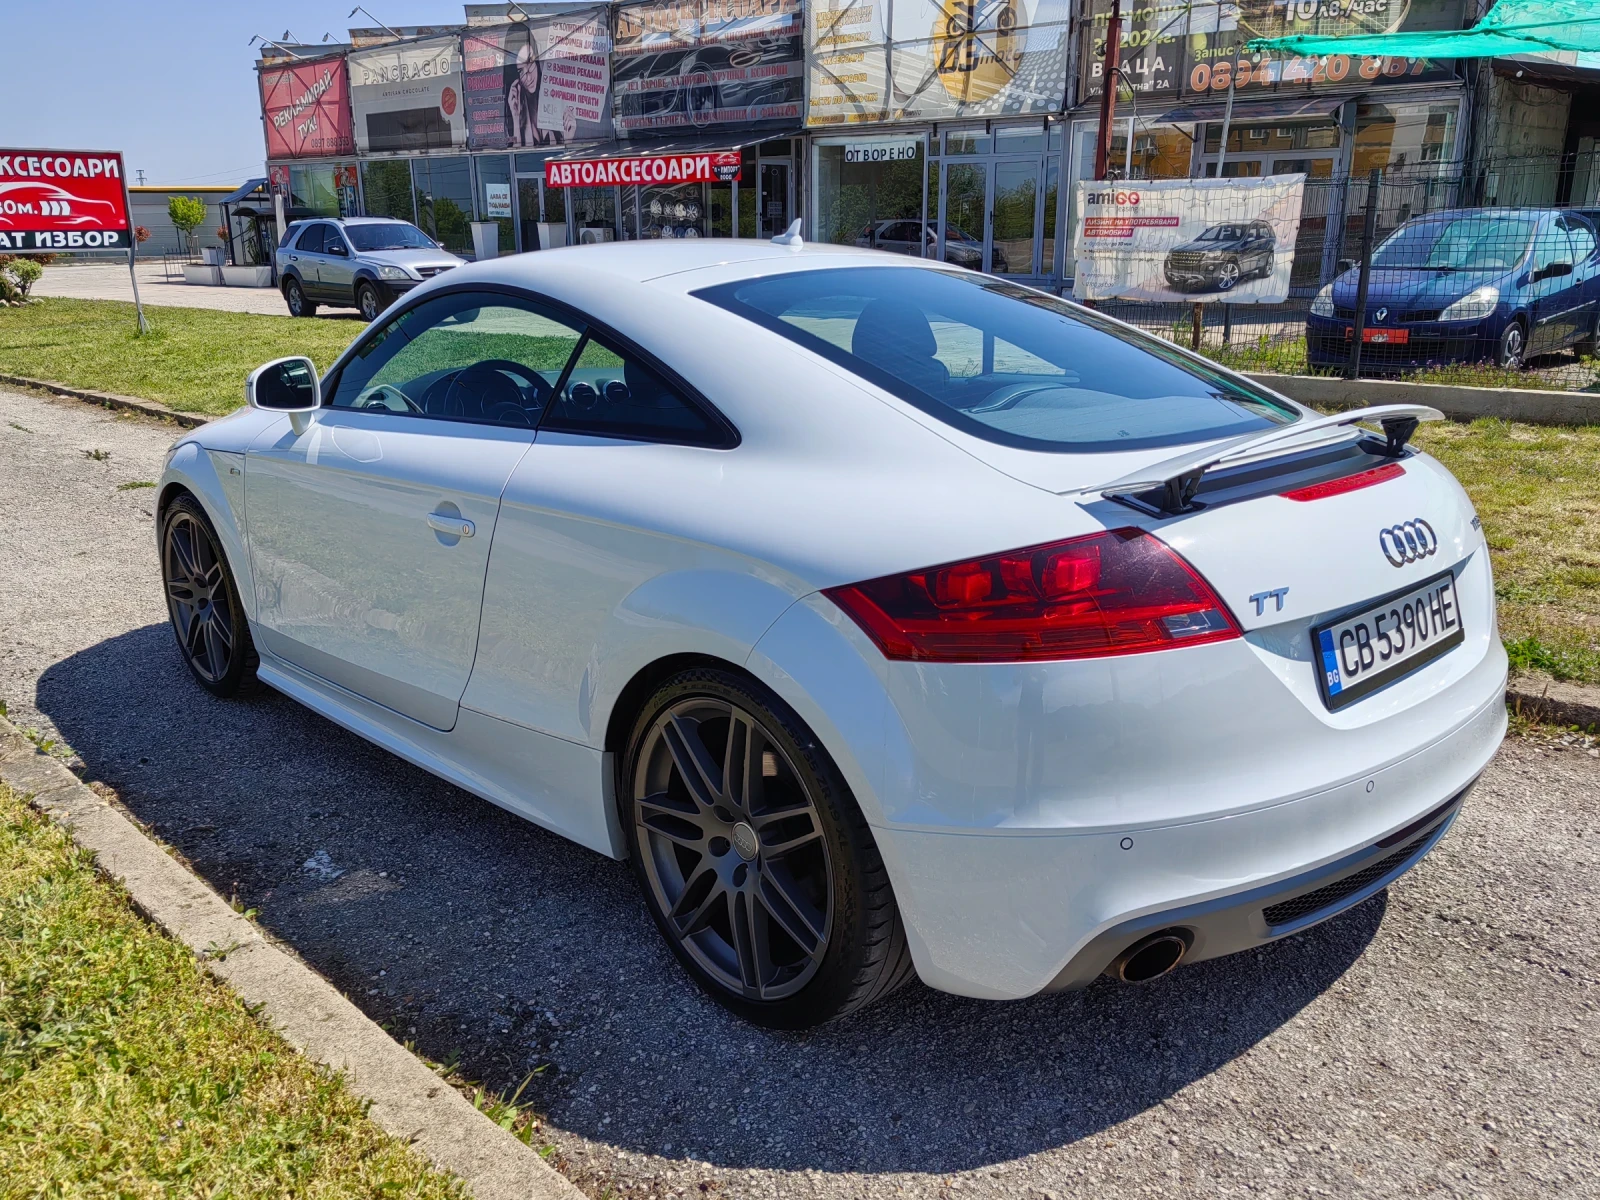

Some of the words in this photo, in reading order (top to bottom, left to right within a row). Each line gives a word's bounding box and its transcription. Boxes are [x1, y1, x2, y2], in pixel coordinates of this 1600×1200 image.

[584, 25, 605, 36] УСЛУГИ
[584, 40, 607, 52] ДИЗАЙН
[579, 54, 606, 67] РЕКЛАМА
[1091, 56, 1173, 78] ВАЦА,
[362, 57, 450, 85] PANCRACIO
[577, 67, 603, 80] РЕКЛАМА
[1190, 57, 1271, 92] 0894
[1283, 53, 1350, 84] 420
[402, 86, 430, 95] CHOCOLATE
[549, 76, 577, 89] РЕКЛАМНИ
[577, 82, 605, 95] СУВЕНИРИ
[273, 69, 333, 130] РЕКЛАМИРАЙ
[550, 89, 577, 102] ФИРМЕНИ
[577, 96, 599, 107] ПЕЧАТИ
[576, 107, 599, 120] ТЕНИСКИ
[298, 115, 318, 140] ТУК!
[846, 146, 915, 162] ОТВОРЕНО
[550, 156, 710, 185] АВТОАКСЕСОАРИ
[1125, 217, 1178, 225] УПОТРЕБЯВАНИ
[35, 230, 119, 248] ИЗБОР
[1086, 228, 1132, 236] АВТОМОБИЛИ
[1249, 586, 1290, 617] TT
[1339, 622, 1375, 679] CB
[1374, 597, 1429, 661] 5390
[1326, 668, 1339, 687] BG
[815, 776, 832, 801] ZR
[835, 826, 846, 852] XL
